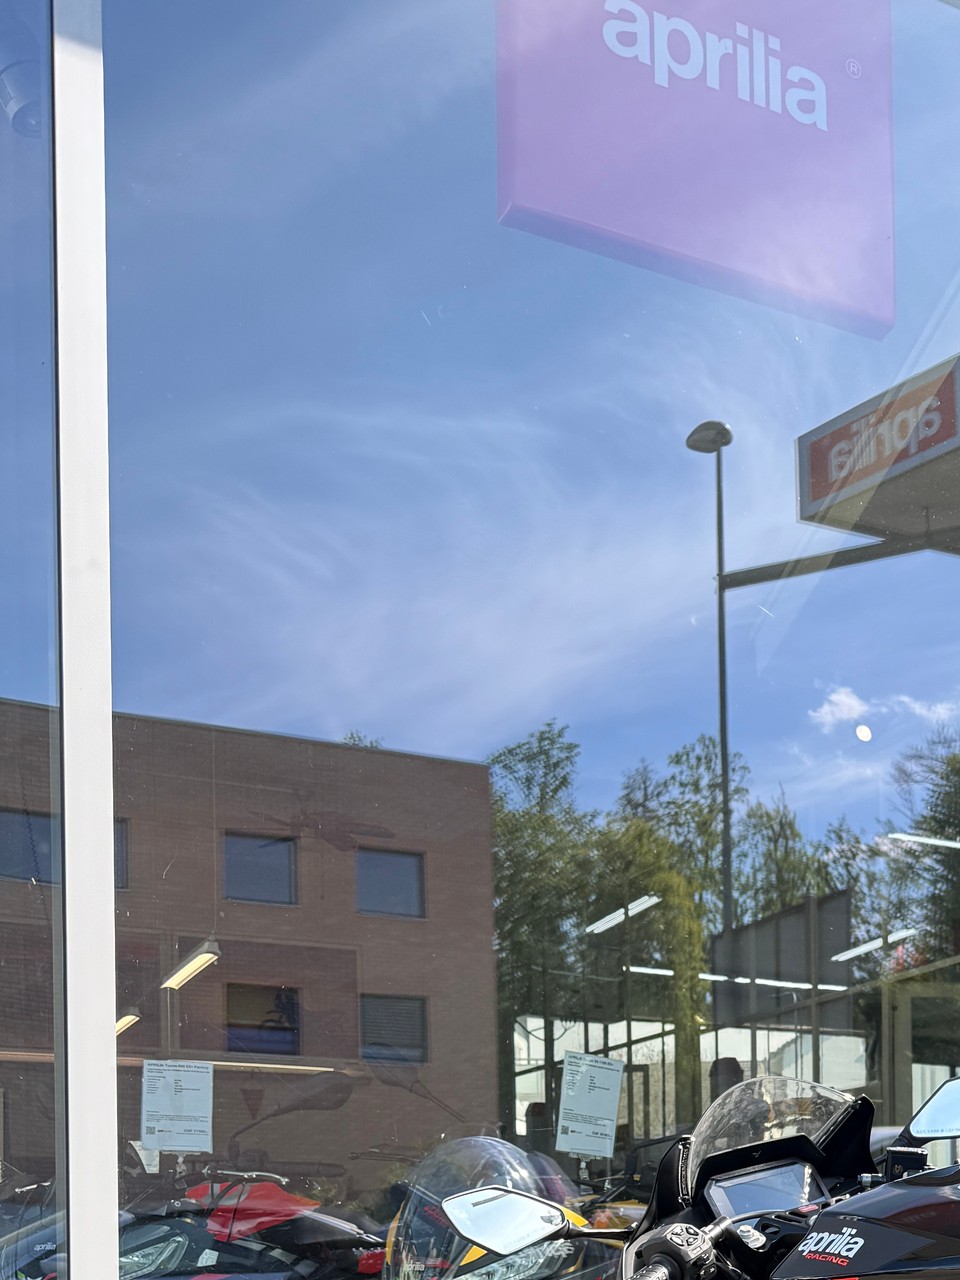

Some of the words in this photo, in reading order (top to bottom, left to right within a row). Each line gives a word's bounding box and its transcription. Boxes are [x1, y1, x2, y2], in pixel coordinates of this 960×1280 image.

[602, 0, 828, 131] aprilia
[798, 1226, 865, 1259] aprilia
[805, 1252, 849, 1267] RACING
